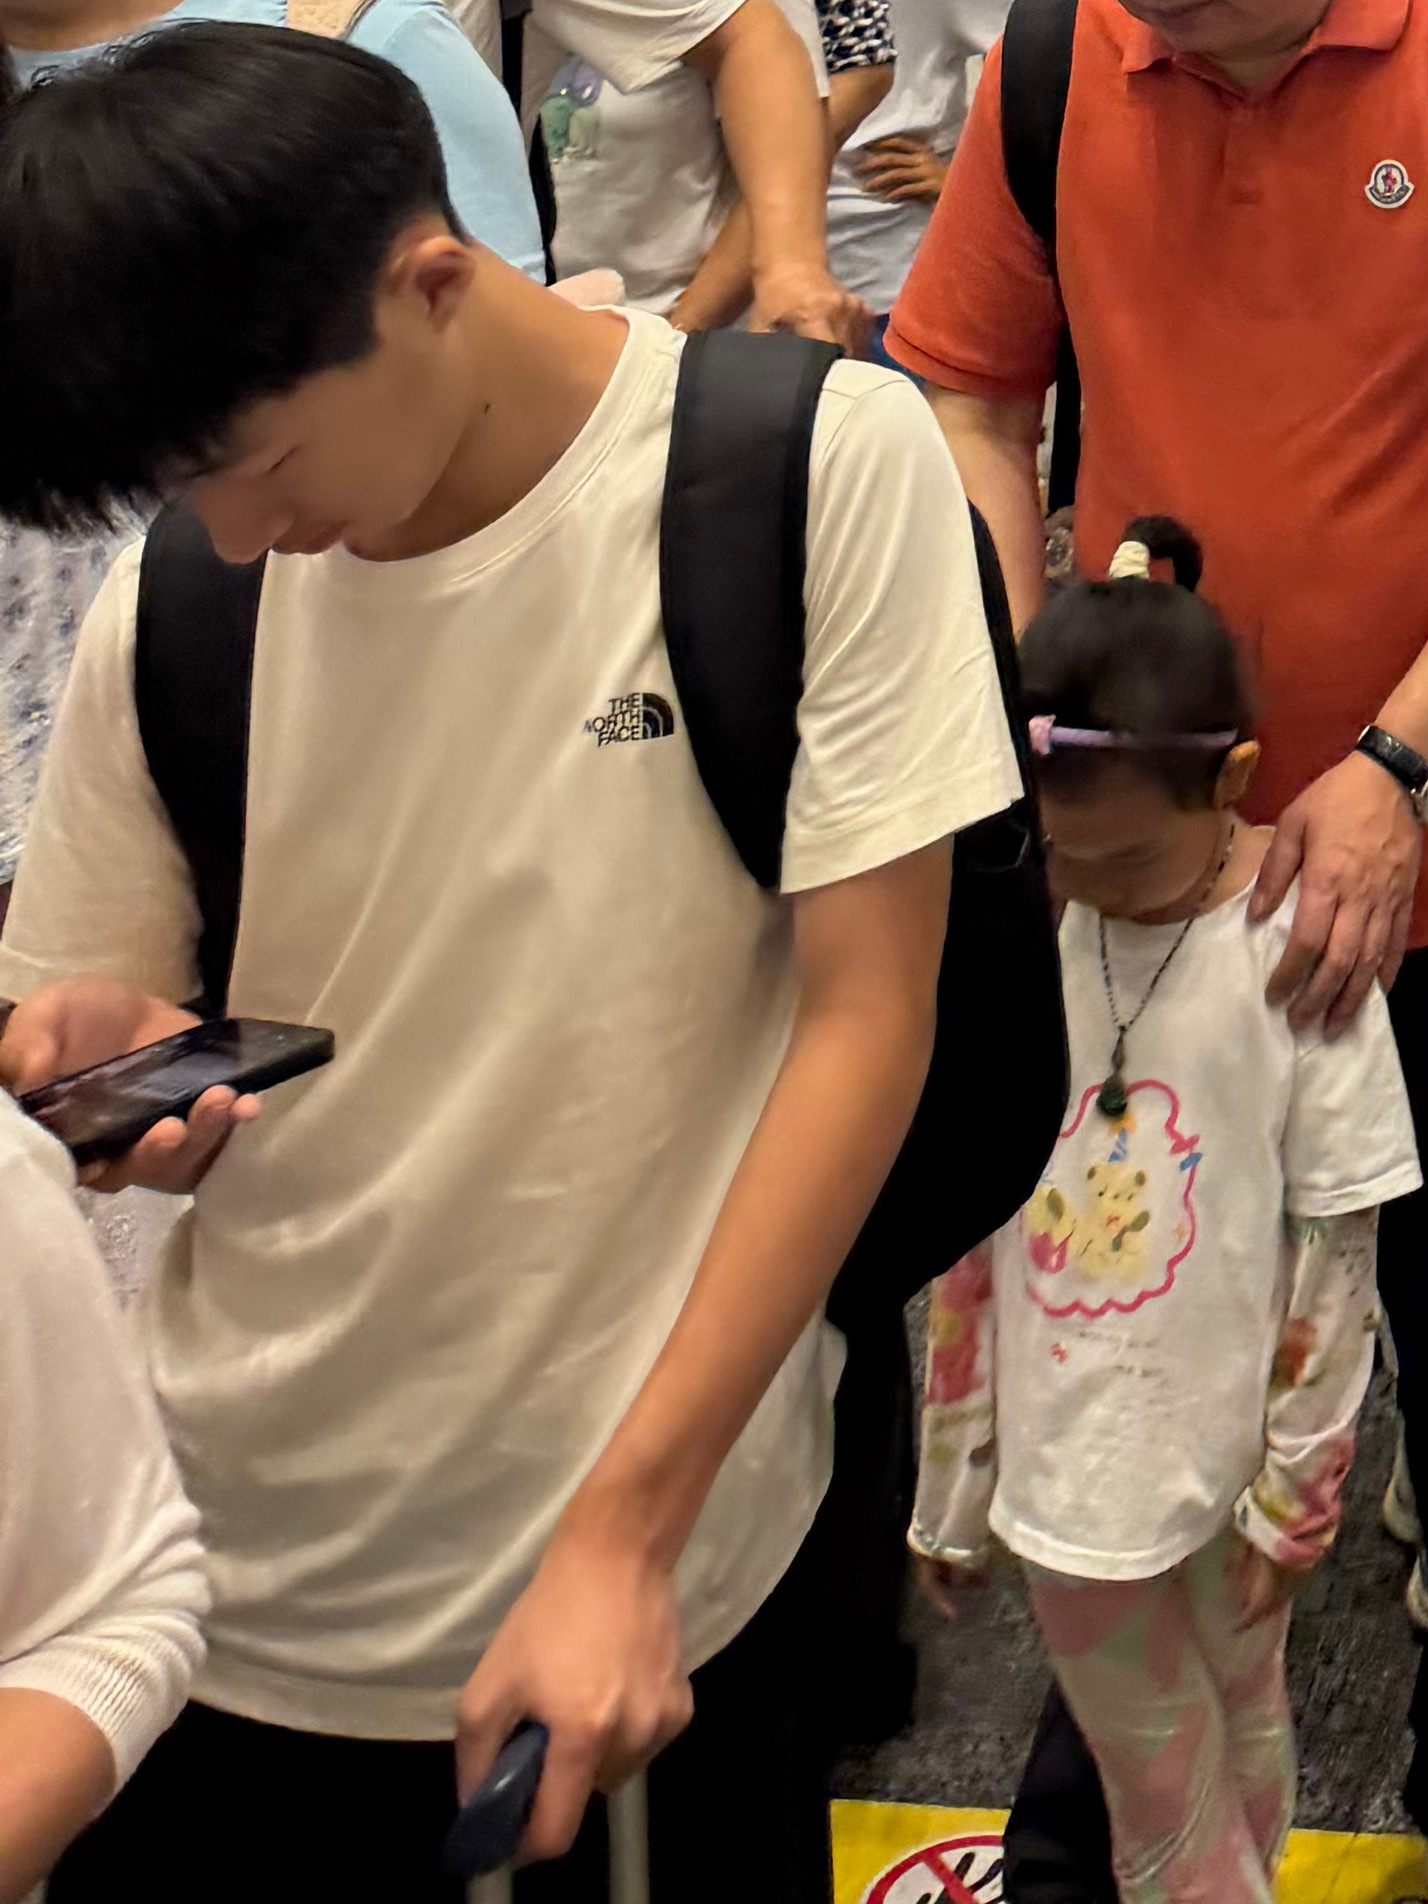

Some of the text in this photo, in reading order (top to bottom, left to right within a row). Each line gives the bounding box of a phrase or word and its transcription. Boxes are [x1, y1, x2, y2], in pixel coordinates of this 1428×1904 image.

[608, 692, 641, 714] THE
[583, 709, 641, 734] NORTH
[597, 724, 641, 748] FACE
